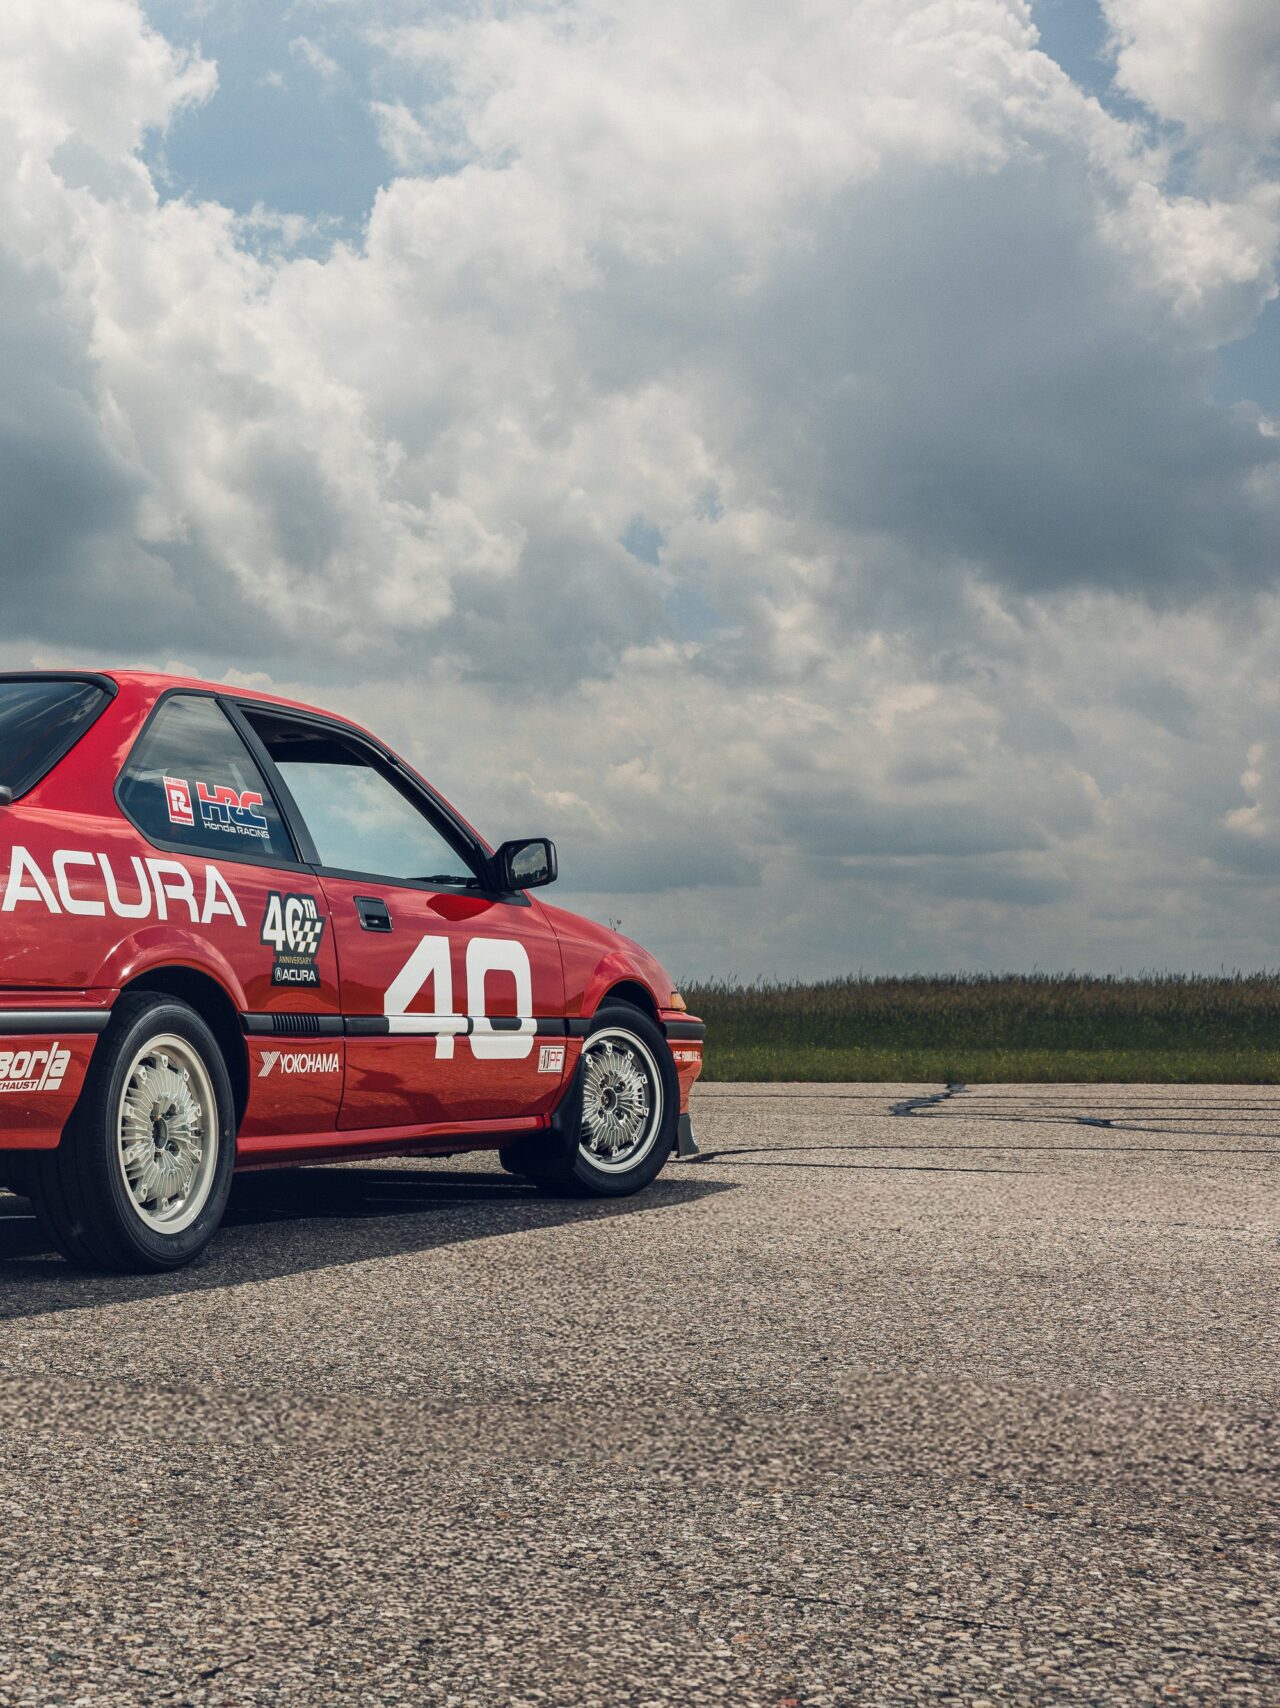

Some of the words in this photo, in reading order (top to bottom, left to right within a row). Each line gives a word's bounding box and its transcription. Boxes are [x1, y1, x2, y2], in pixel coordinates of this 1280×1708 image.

[196, 781, 268, 830] HRC
[204, 821, 236, 834] Honda
[237, 826, 270, 839] RACING
[1, 845, 247, 927] ACURA
[278, 955, 313, 965] ANNIVERSARY
[282, 968, 317, 982] ACURA
[383, 934, 538, 1059] 40
[280, 1053, 339, 1073] YOKOHAMA
